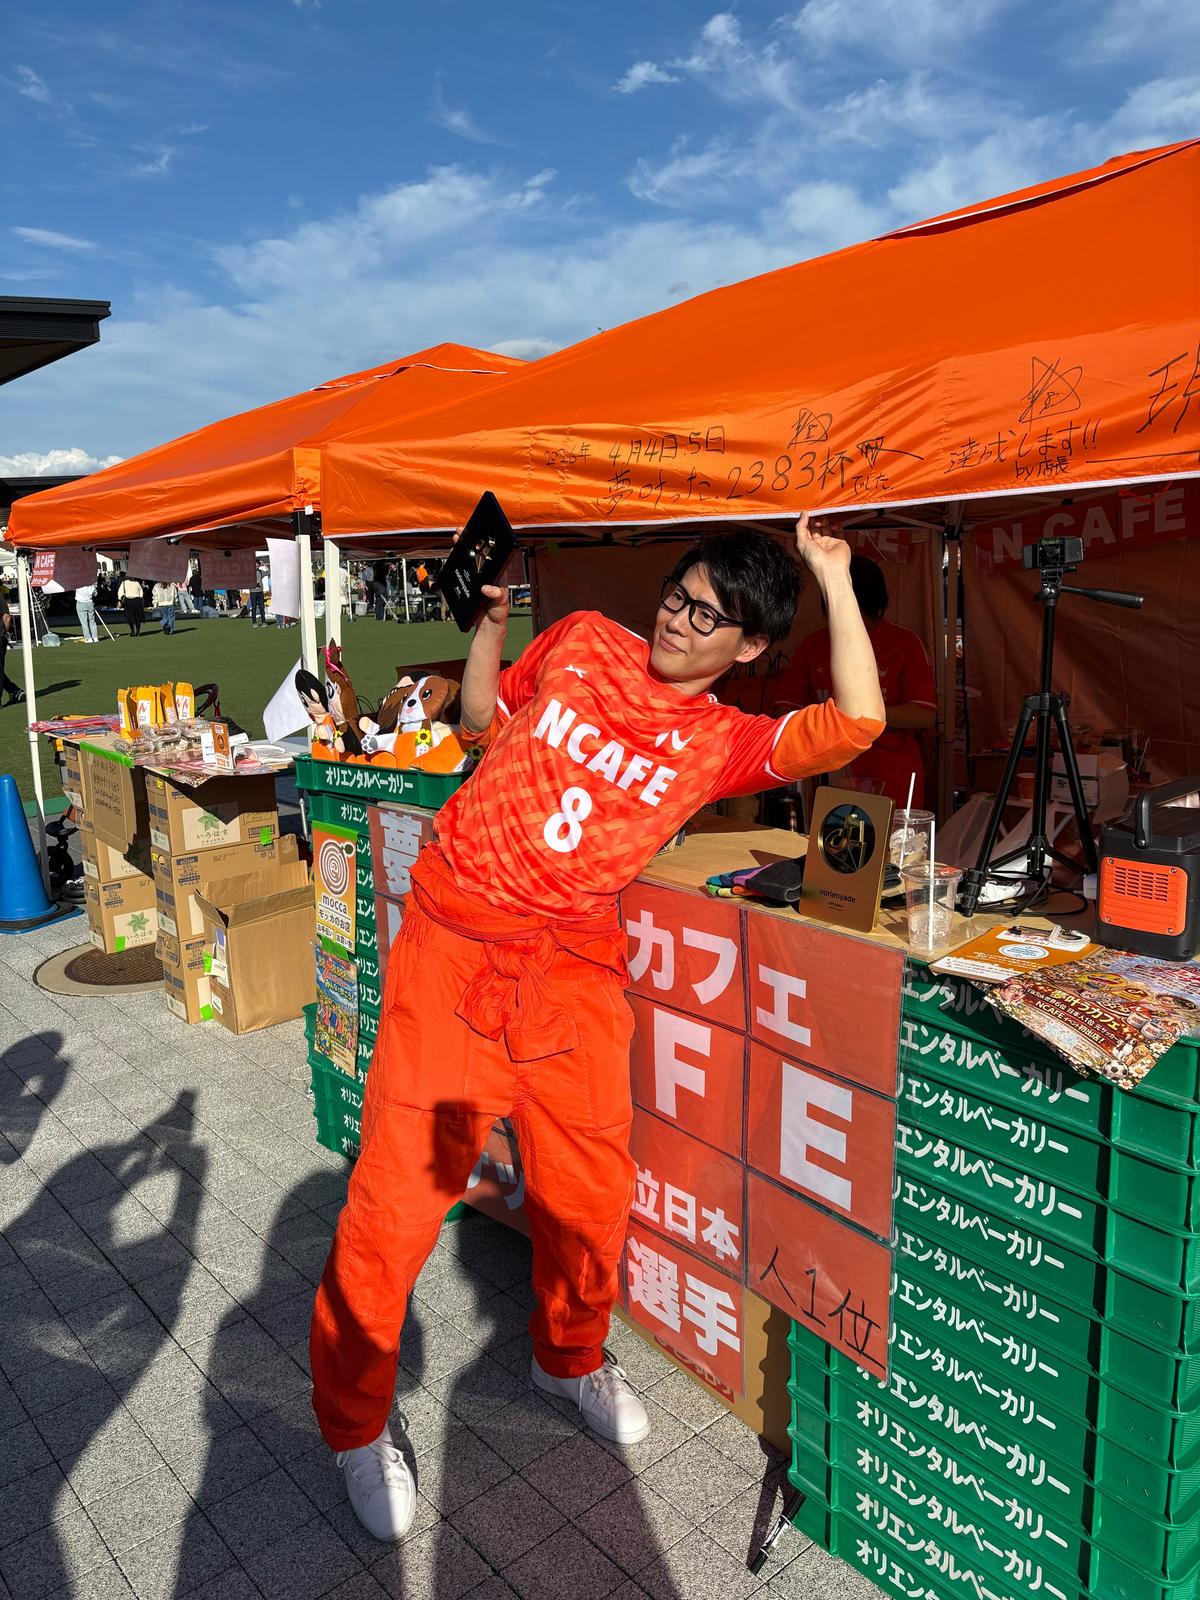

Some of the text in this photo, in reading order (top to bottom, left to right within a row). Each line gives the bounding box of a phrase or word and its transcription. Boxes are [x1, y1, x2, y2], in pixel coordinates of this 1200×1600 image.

[991, 487, 1186, 564] N CAFE
[325, 766, 414, 795] オリエンタルベーカリー
[533, 698, 678, 807] NCAFE
[543, 786, 593, 853] 8
[321, 893, 348, 916] mocca
[1035, 1000, 1065, 1021] NCAFE
[627, 1237, 741, 1356] 選手
[855, 1400, 1068, 1548] オリエンタルベーカリー
[855, 1448, 1067, 1600] オリエンタルベーカリー
[855, 1491, 1017, 1600] オリエンタルベー
